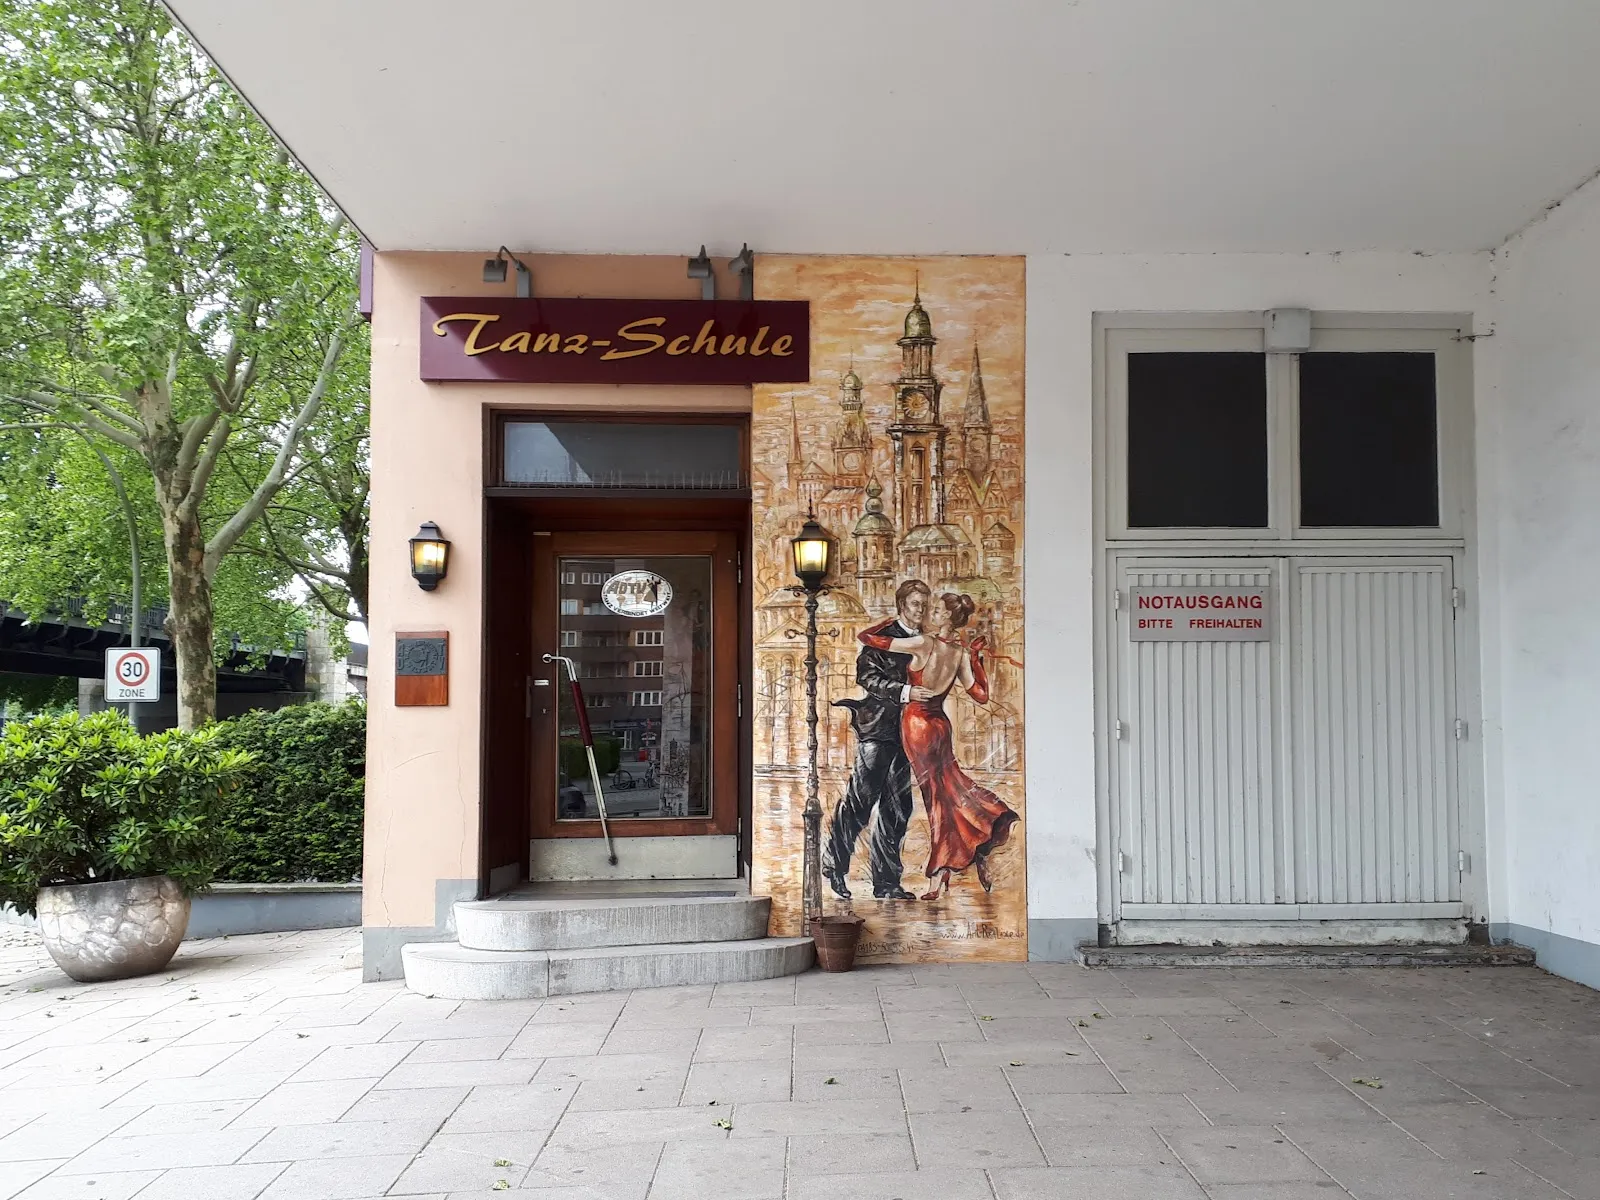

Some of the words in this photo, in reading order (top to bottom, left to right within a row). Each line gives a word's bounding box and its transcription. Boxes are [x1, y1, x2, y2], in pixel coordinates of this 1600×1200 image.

[433, 313, 794, 361] Tanz-Schule
[606, 580, 648, 595] ADTV
[613, 605, 648, 616] VERBINDET
[649, 592, 671, 613] WELTWEIT
[1138, 595, 1263, 609] NOTAUSGANG
[1138, 619, 1173, 629] BITTE
[1189, 619, 1262, 629] FREIHALTEN
[122, 662, 142, 677] 30
[119, 689, 146, 698] ZONE
